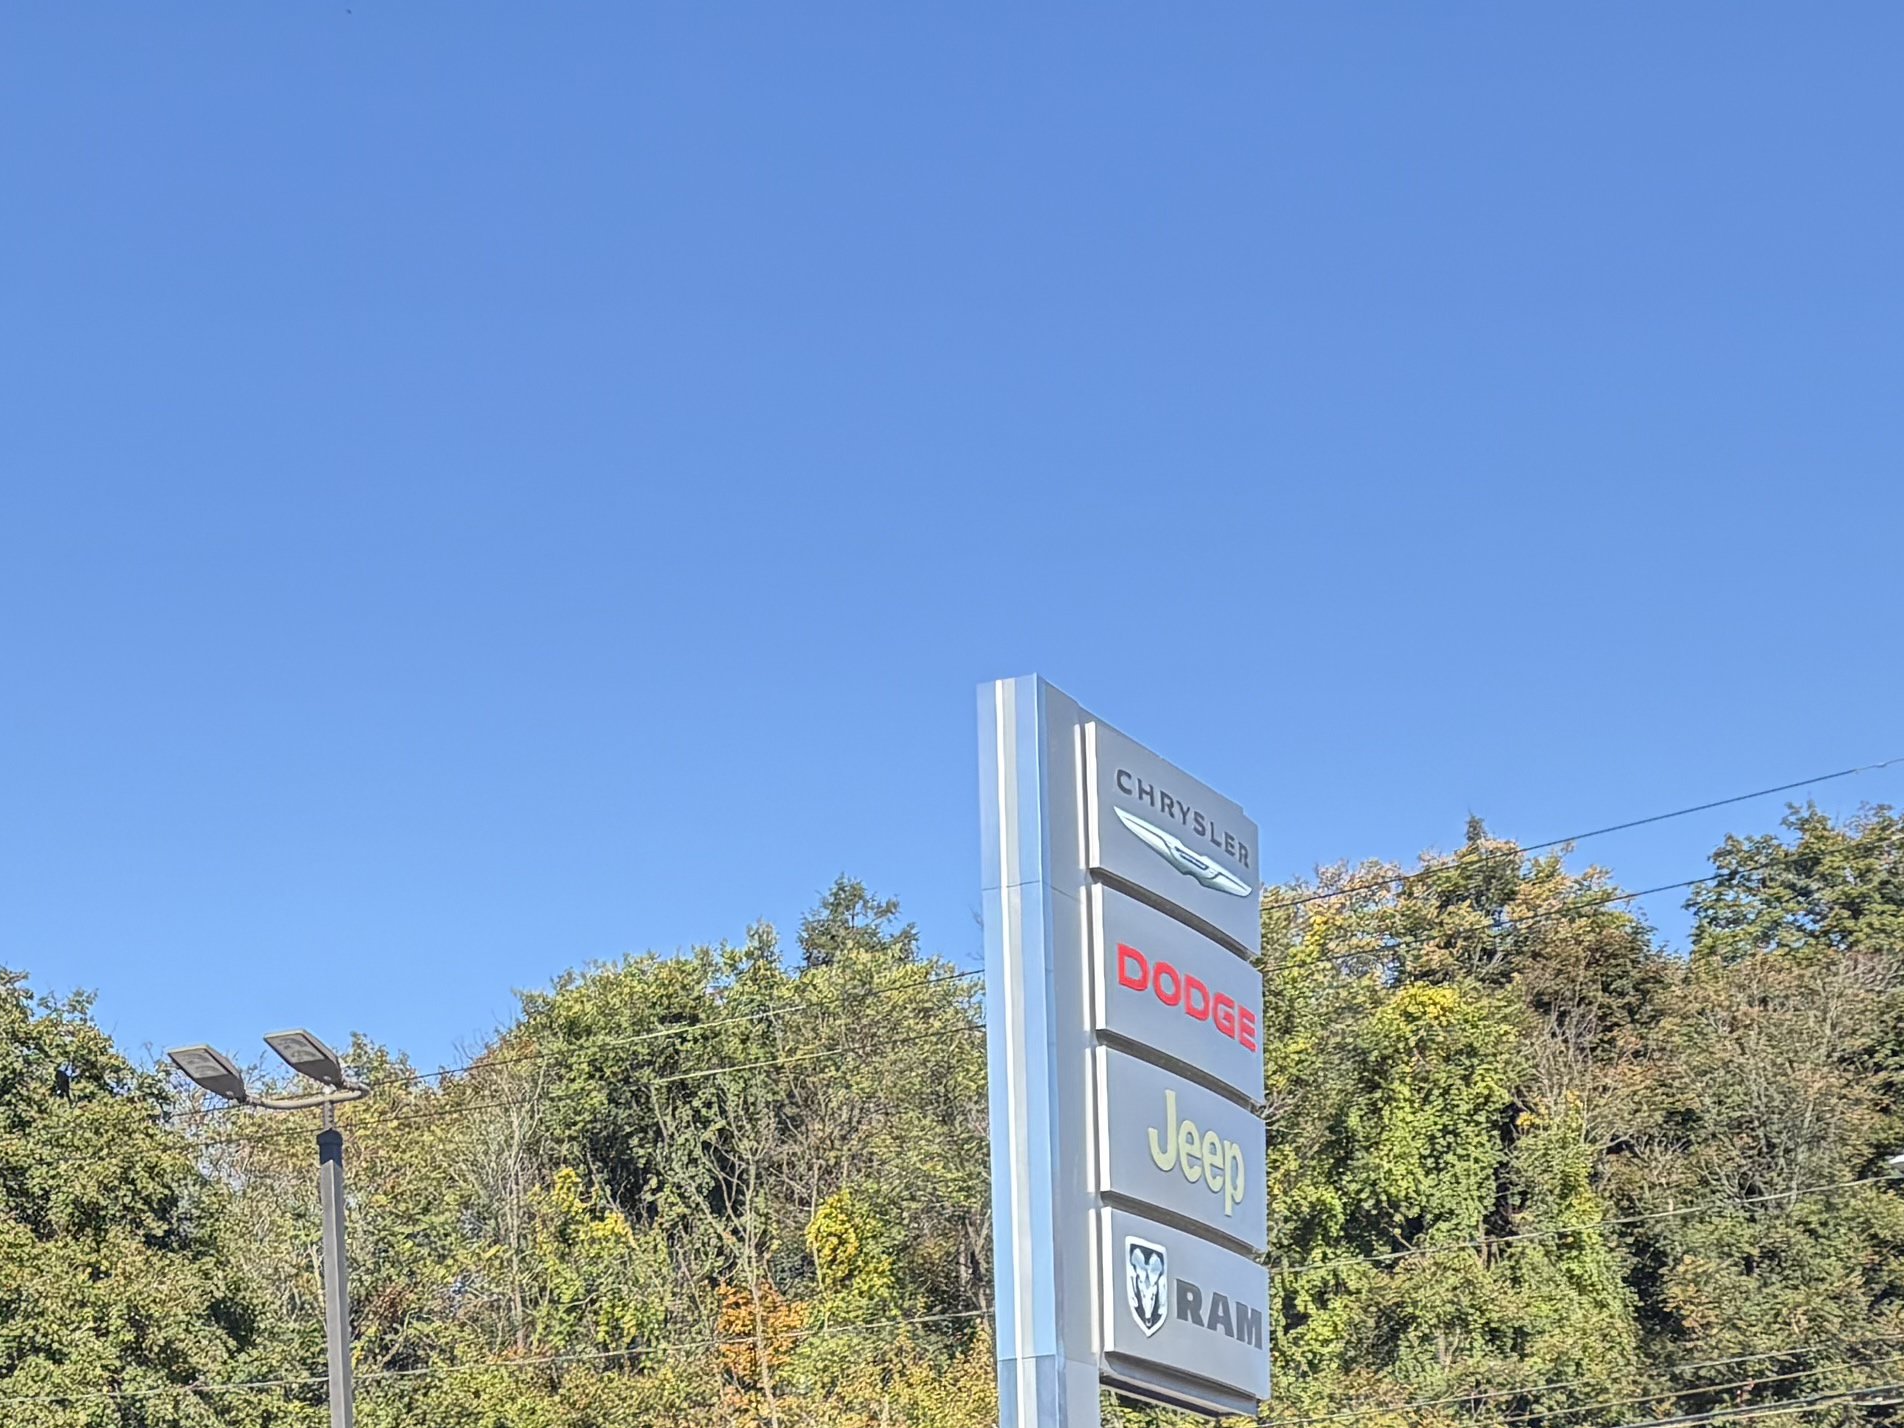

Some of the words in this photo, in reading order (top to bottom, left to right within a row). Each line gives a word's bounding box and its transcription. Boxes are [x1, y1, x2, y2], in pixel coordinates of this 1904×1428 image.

[1116, 768, 1250, 868] CHRYSLER
[1116, 942, 1258, 1053] DODGE
[1147, 1088, 1246, 1217] Jeep
[1176, 1278, 1264, 1350] RAM
